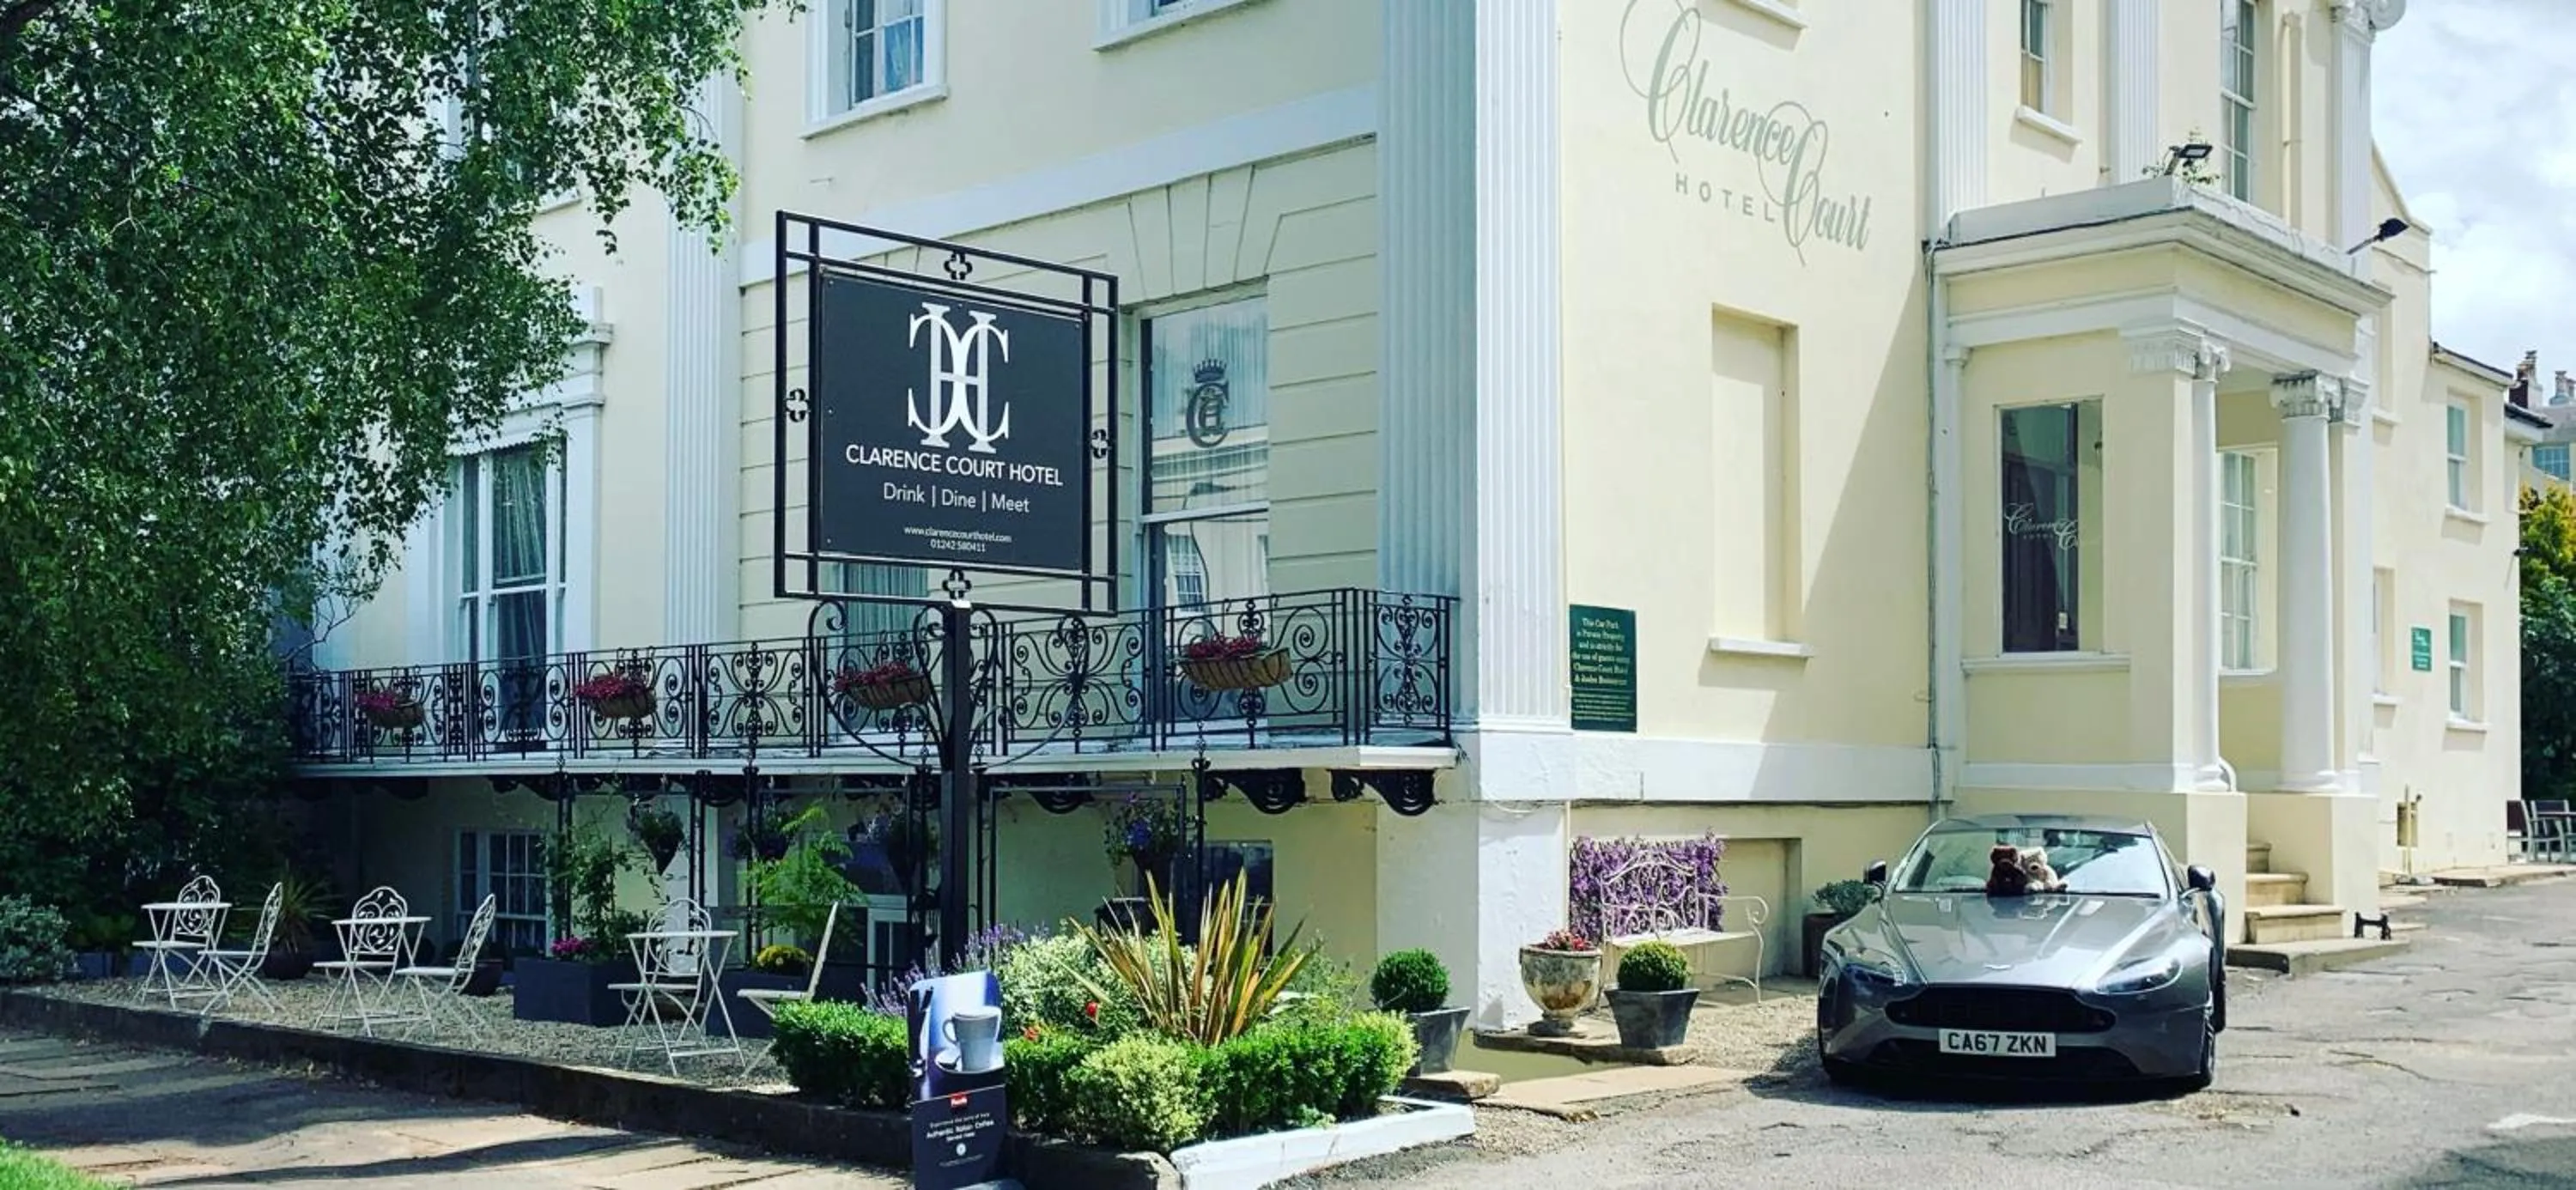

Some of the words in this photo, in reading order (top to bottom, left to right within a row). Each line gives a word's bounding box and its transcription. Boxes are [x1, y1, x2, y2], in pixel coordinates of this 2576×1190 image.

[1619, 0, 1795, 165] Clarence
[1758, 100, 1872, 268] Court
[1674, 172, 1776, 222] HOTEL
[845, 444, 942, 472] CLARENCE
[945, 456, 1005, 478] COURT
[1009, 463, 1064, 486] HOTEL
[884, 482, 926, 503] Drink
[941, 489, 977, 508] Dine
[991, 492, 1030, 513] Meet
[903, 526, 1012, 543] www.clarencecourthotel.com
[1947, 1032, 2001, 1052] CA67
[2005, 1035, 2047, 1053] ZKN
